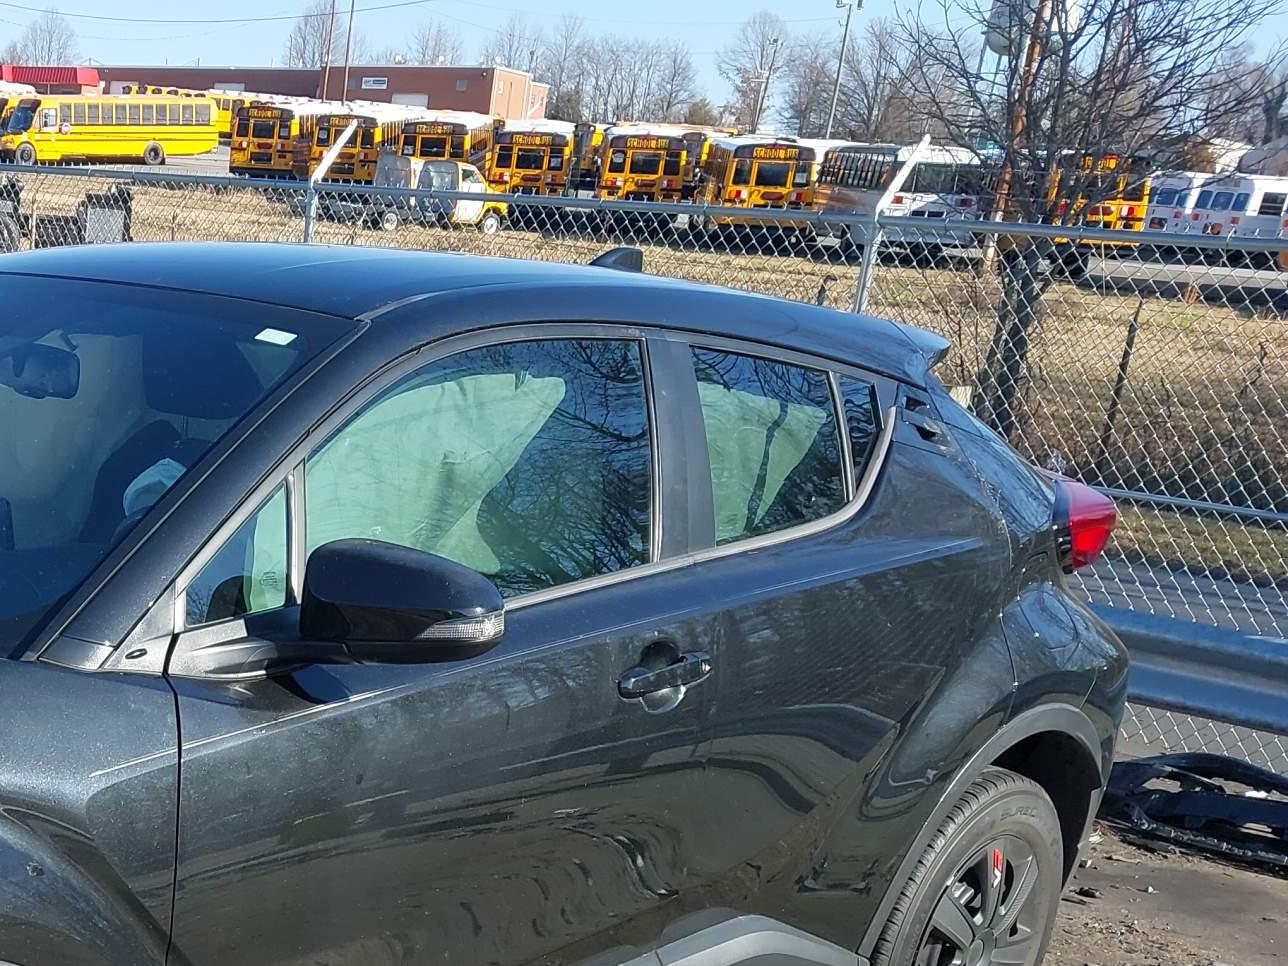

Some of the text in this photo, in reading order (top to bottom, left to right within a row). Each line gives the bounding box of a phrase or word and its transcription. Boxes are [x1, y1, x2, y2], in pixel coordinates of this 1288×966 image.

[513, 134, 541, 145] SCHOOL
[627, 138, 670, 149] SCHOOL BUS
[753, 147, 799, 160] SCHOOL BUS
